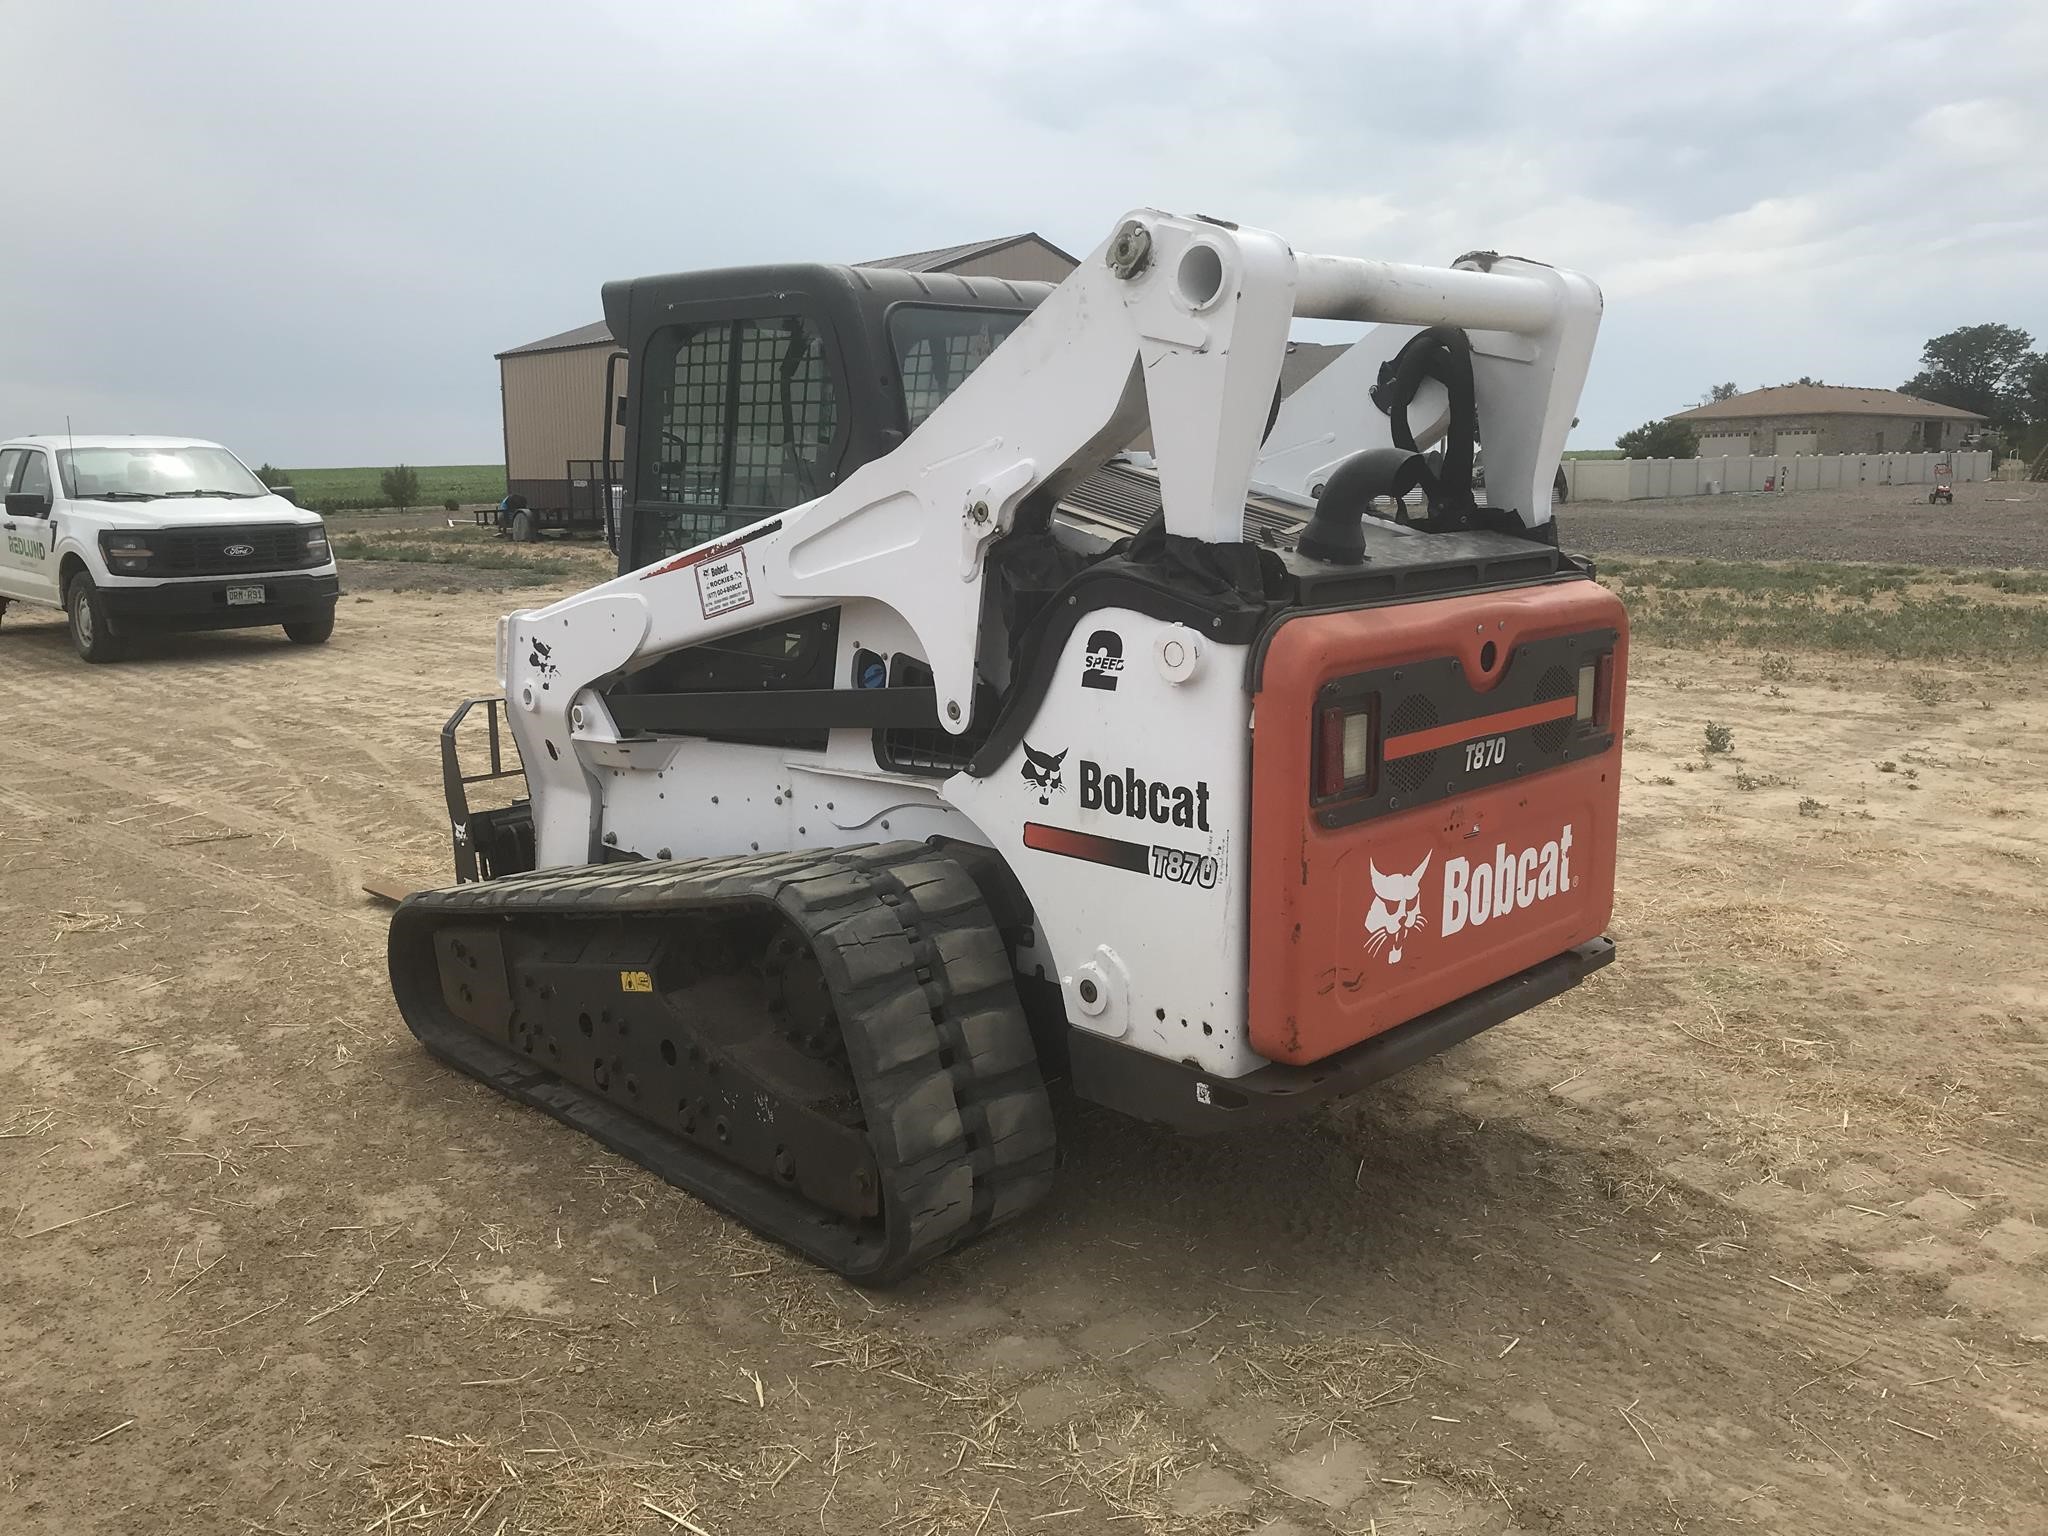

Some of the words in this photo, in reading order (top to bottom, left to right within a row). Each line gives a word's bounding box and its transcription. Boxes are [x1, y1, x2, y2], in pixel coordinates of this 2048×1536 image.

[8, 535, 46, 561] REDLUND
[710, 575, 734, 587] ROCKIES
[711, 563, 728, 577] Bobcat
[1081, 630, 1123, 691] 2
[1085, 655, 1125, 671] SPEED
[1465, 736, 1506, 772] T870
[1079, 759, 1210, 832] Bobcat
[1151, 844, 1218, 889] T870
[1441, 823, 1572, 938] Bobcat
